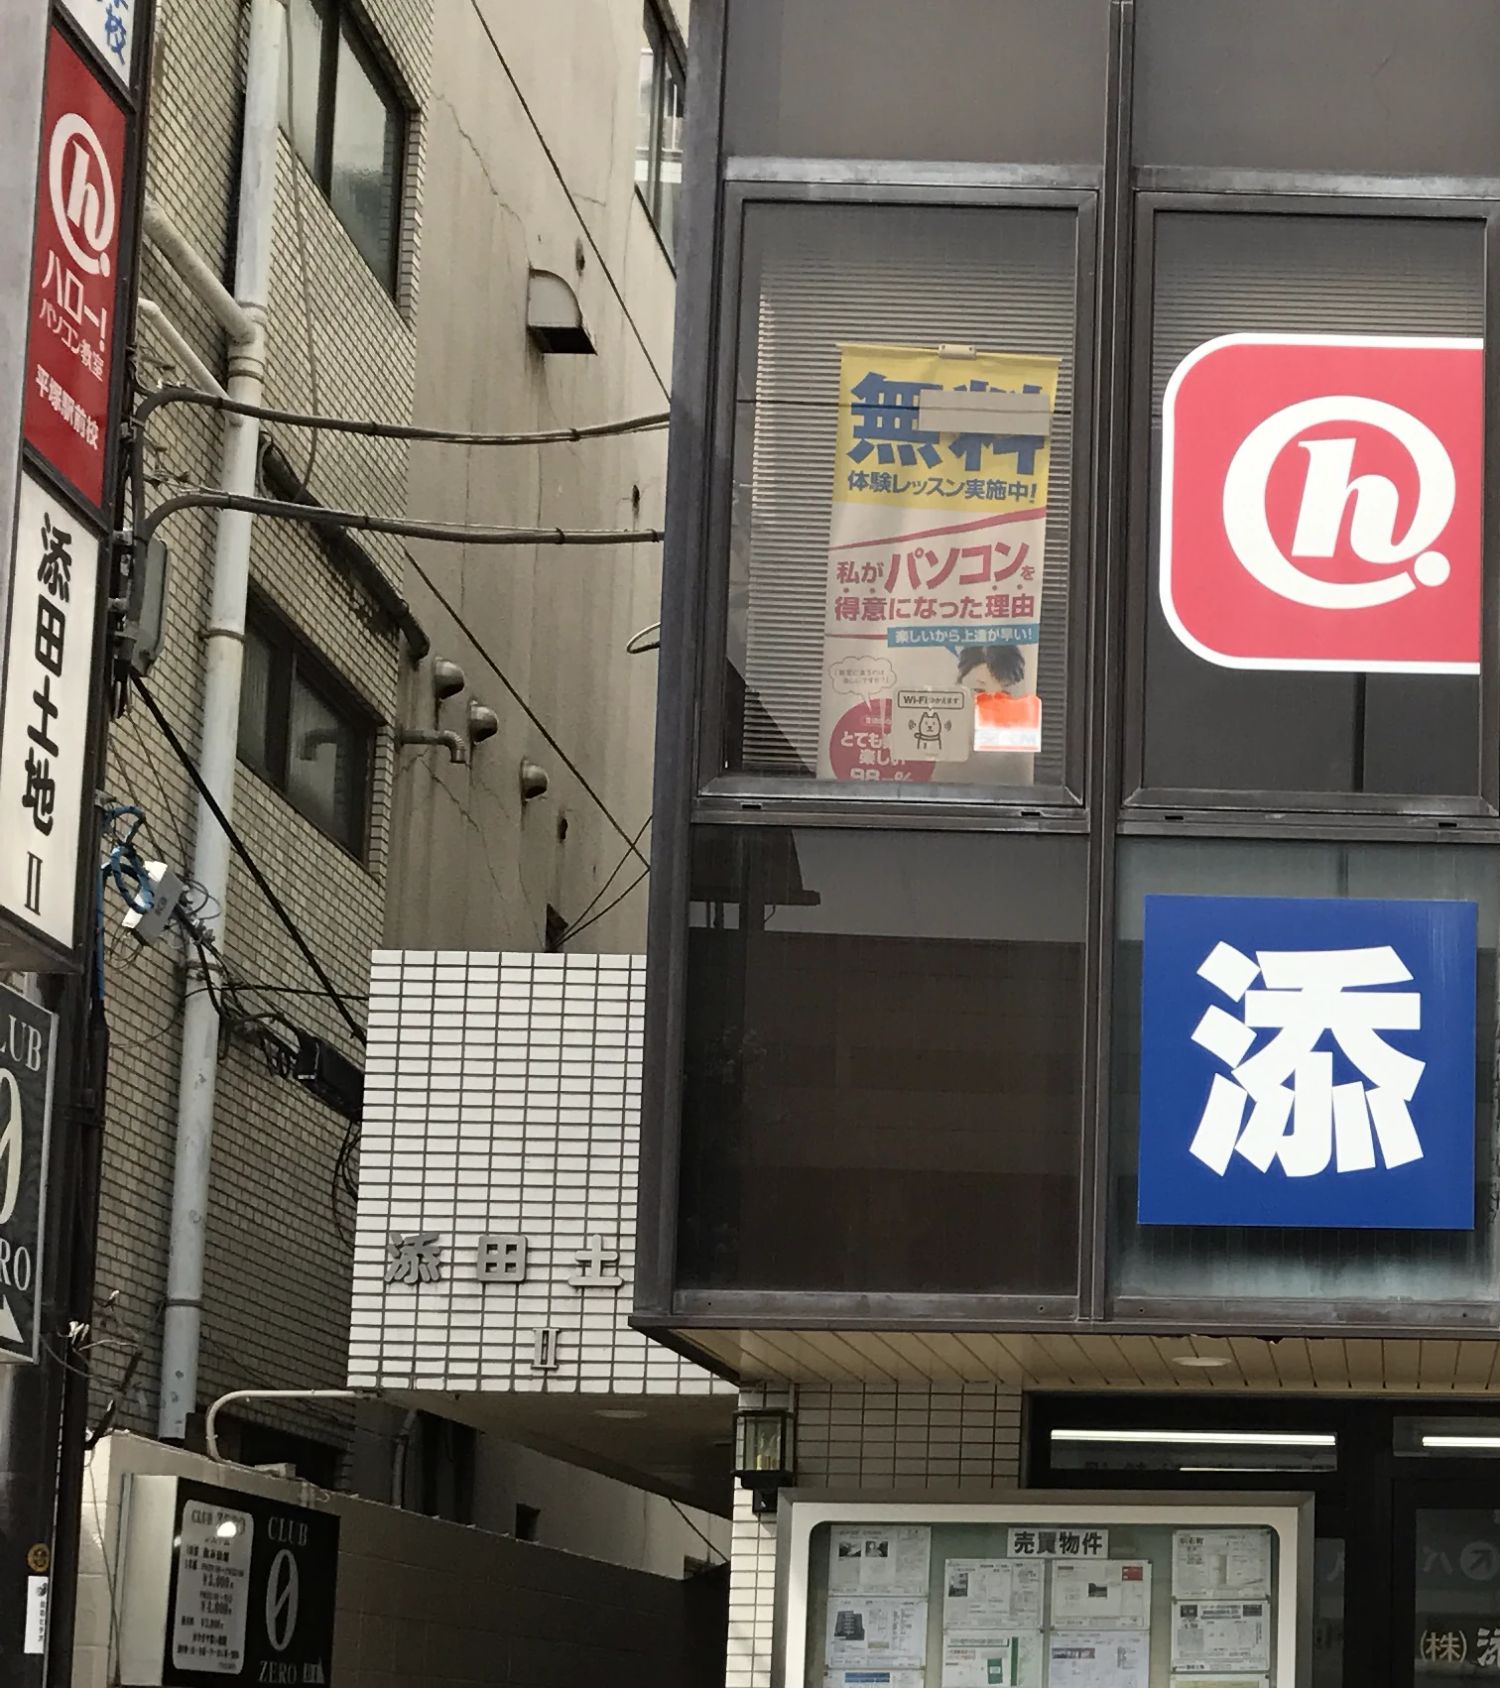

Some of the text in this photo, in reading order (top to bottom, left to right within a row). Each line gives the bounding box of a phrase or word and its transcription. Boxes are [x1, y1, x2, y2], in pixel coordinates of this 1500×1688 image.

[42, 249, 108, 352] ハロー!
[847, 470, 1038, 504] 体験レッスン実施中!
[833, 593, 1036, 622] 得意になった理由
[0, 1014, 42, 1072] UB
[268, 1516, 310, 1547] CLUB
[1014, 1530, 1103, 1556] 売買物件
[258, 1659, 298, 1685] ZERO
